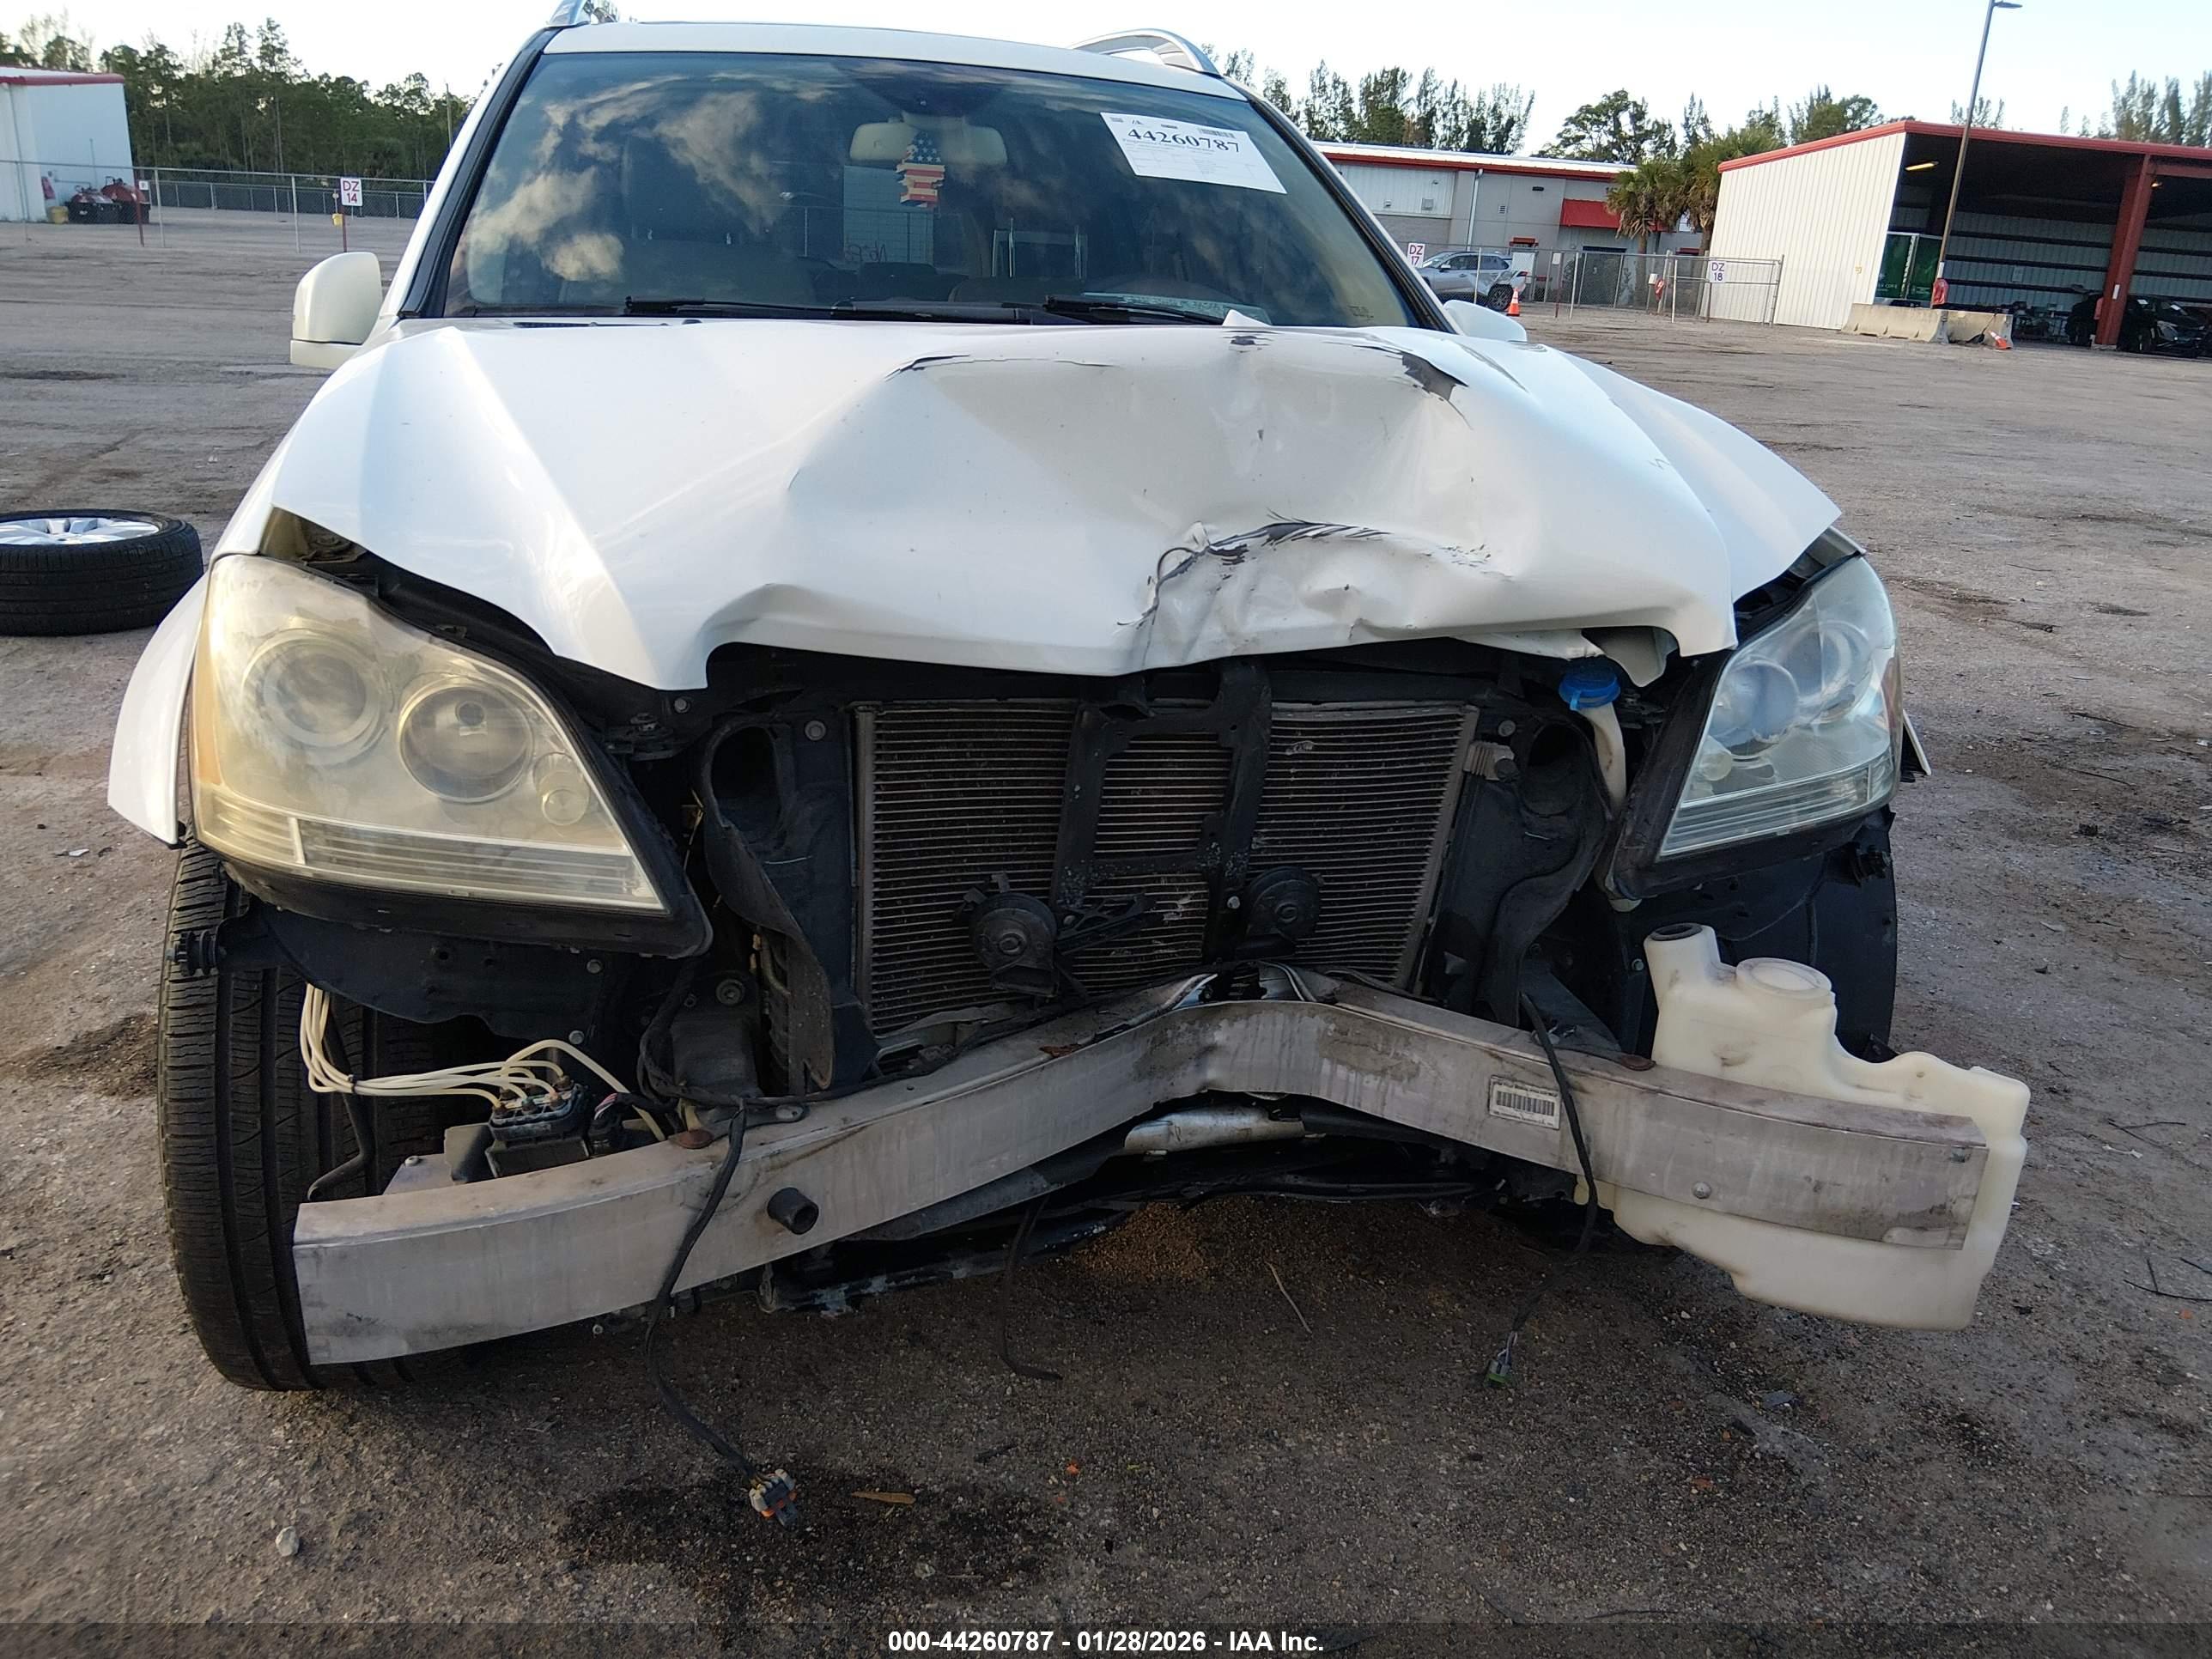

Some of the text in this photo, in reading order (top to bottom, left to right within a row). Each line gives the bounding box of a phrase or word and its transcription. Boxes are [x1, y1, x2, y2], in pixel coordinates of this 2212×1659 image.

[1127, 128, 1240, 153] 44260787
[343, 181, 360, 191] DZ
[347, 192, 357, 204] 14
[1409, 245, 1423, 255] DZ
[1411, 256, 1419, 265] 17
[1711, 262, 1724, 271] DZ
[1714, 272, 1723, 281] 18
